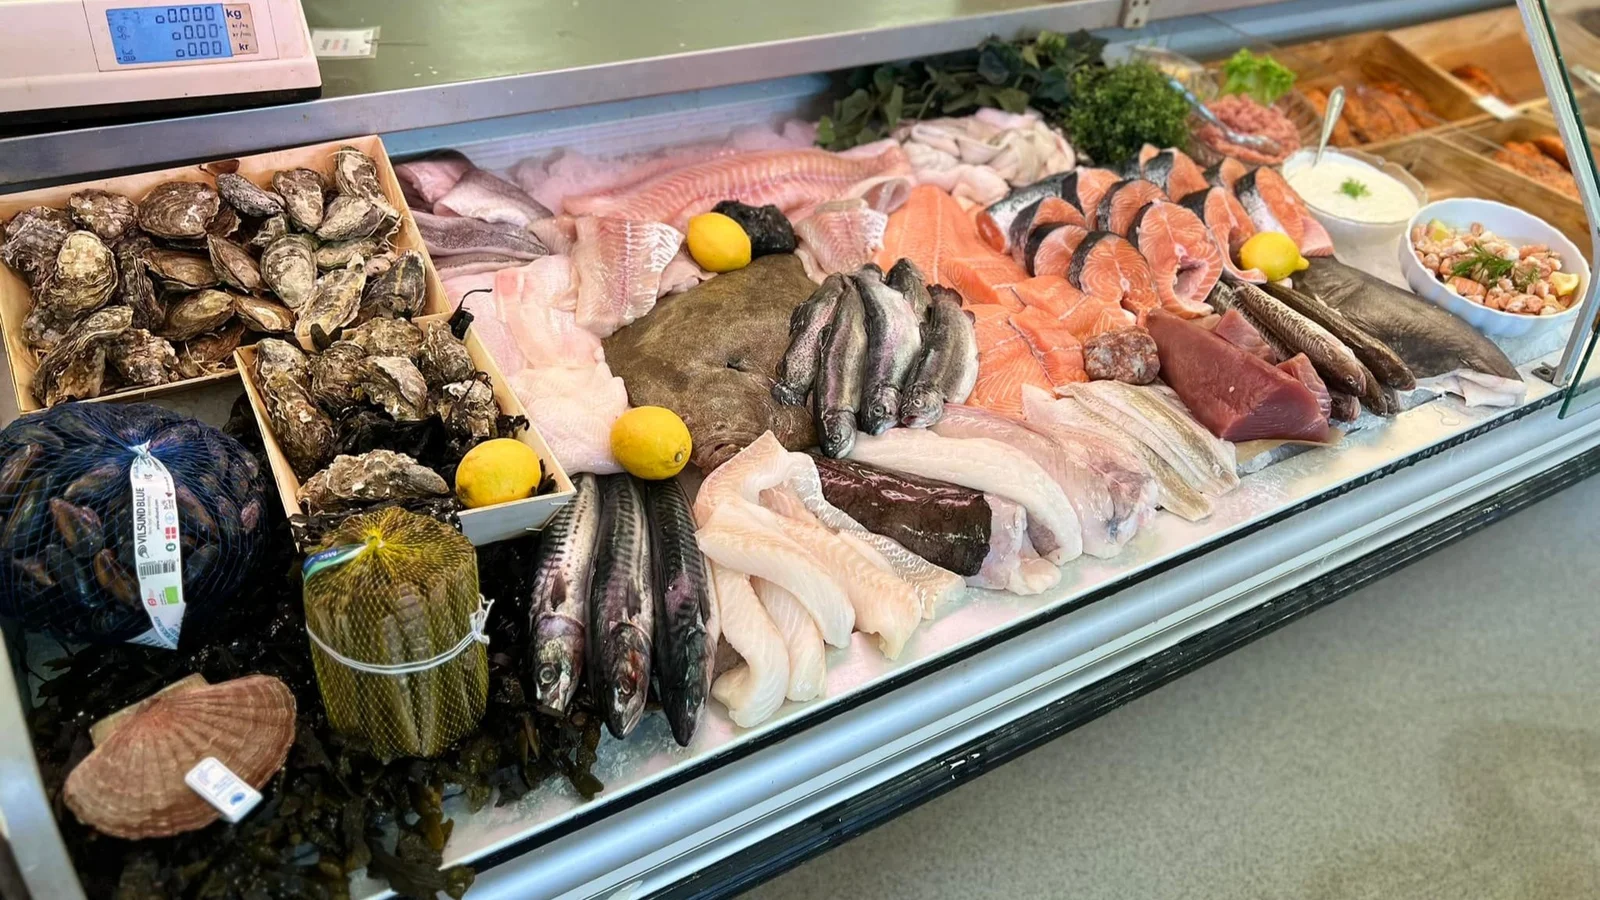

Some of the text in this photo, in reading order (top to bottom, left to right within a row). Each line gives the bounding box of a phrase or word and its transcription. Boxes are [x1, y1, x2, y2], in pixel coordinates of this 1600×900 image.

[226, 8, 242, 20] kg
[239, 43, 249, 51] kr
[135, 487, 145, 507] BLUE
[136, 508, 147, 545] VILSUND
